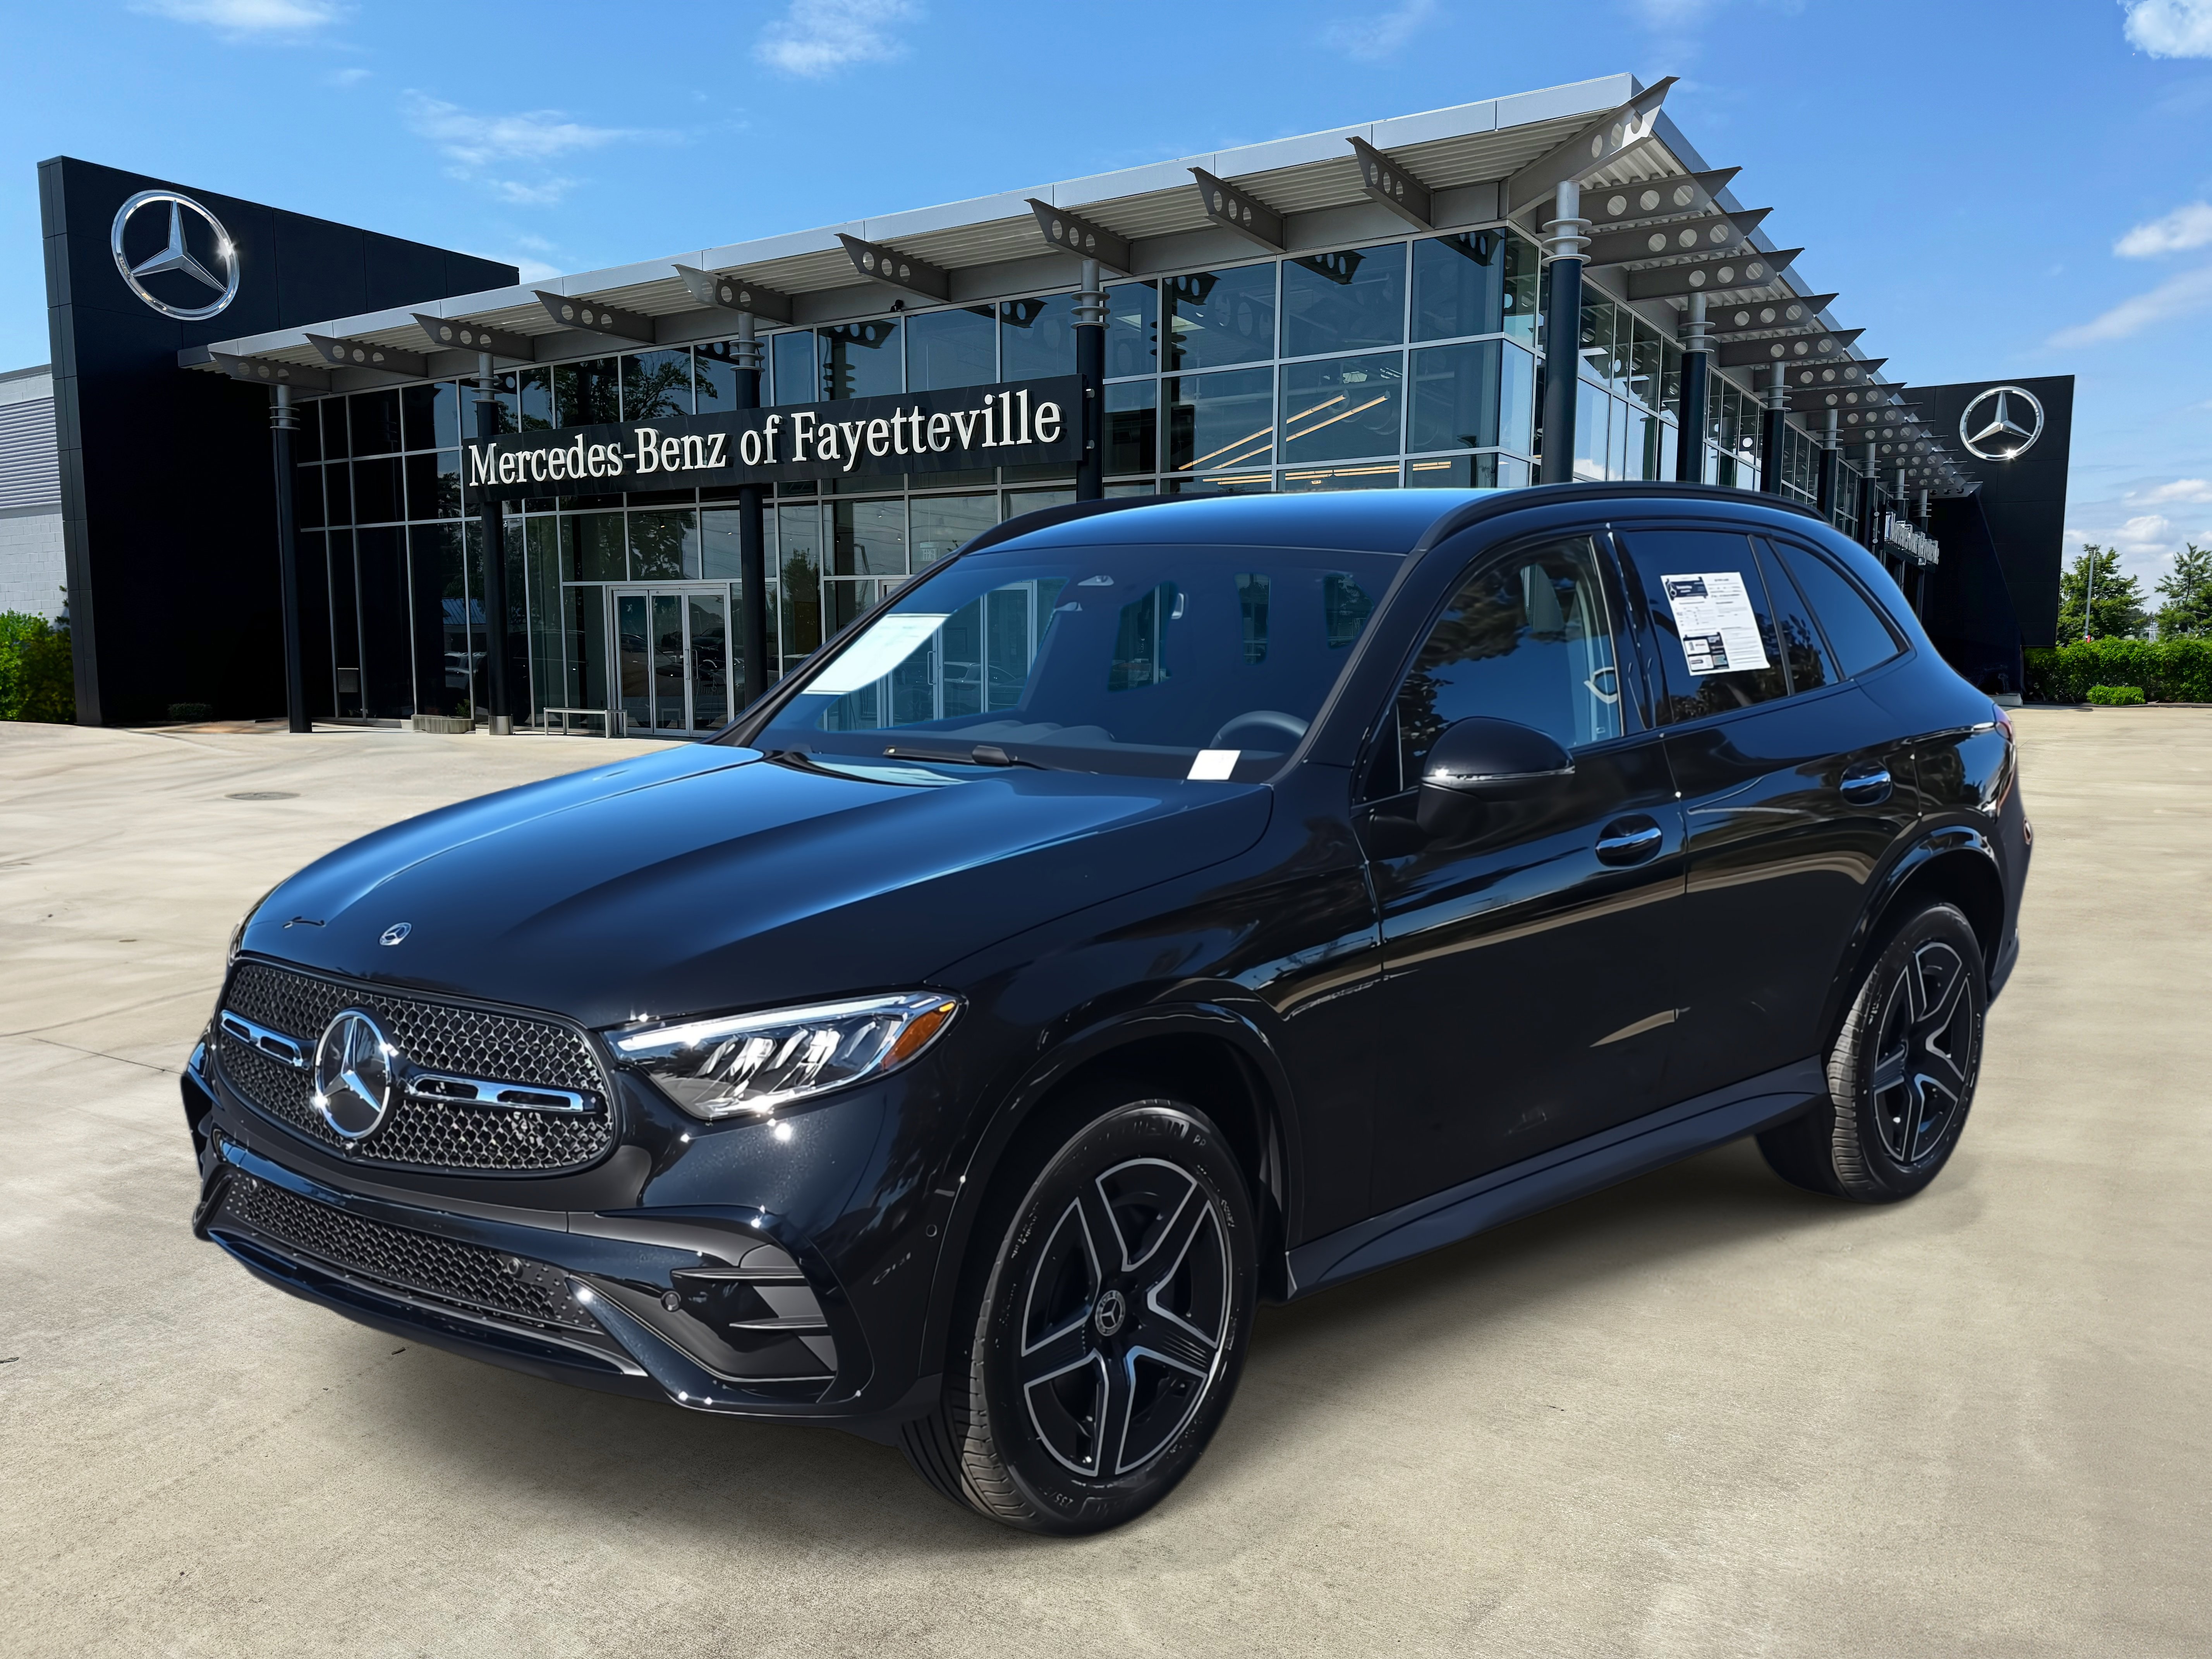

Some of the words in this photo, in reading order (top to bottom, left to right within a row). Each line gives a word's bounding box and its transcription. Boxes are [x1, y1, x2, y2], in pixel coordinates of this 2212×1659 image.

[469, 427, 726, 487] Mercedes-Benz
[740, 414, 783, 466] of
[790, 388, 1061, 472] Fayetteville
